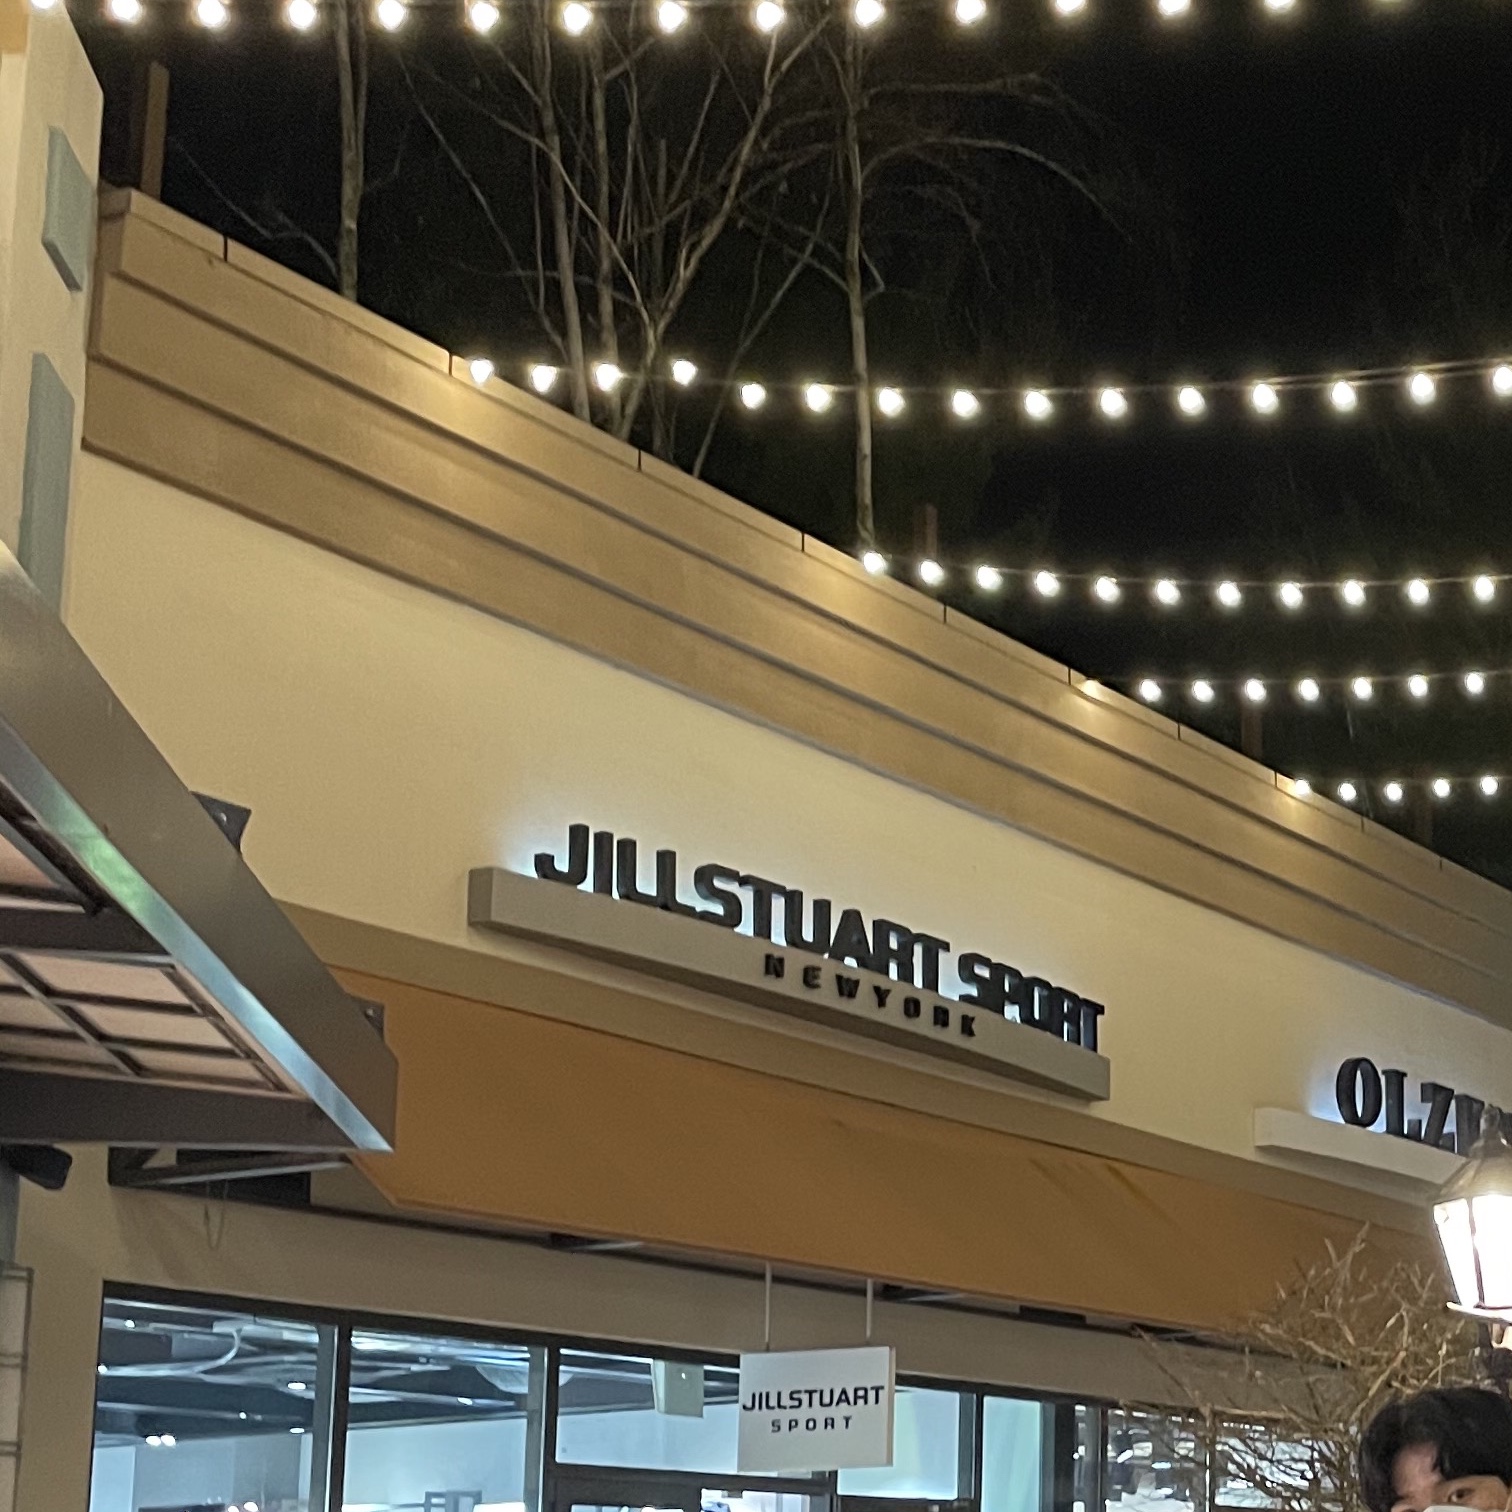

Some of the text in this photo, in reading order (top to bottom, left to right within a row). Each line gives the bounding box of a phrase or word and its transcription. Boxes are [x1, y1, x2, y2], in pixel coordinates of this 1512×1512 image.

[534, 823, 1105, 1054] JILLSTUART SPORT
[742, 1385, 885, 1411] JILLSTUART
[771, 1415, 852, 1432] SPORT
